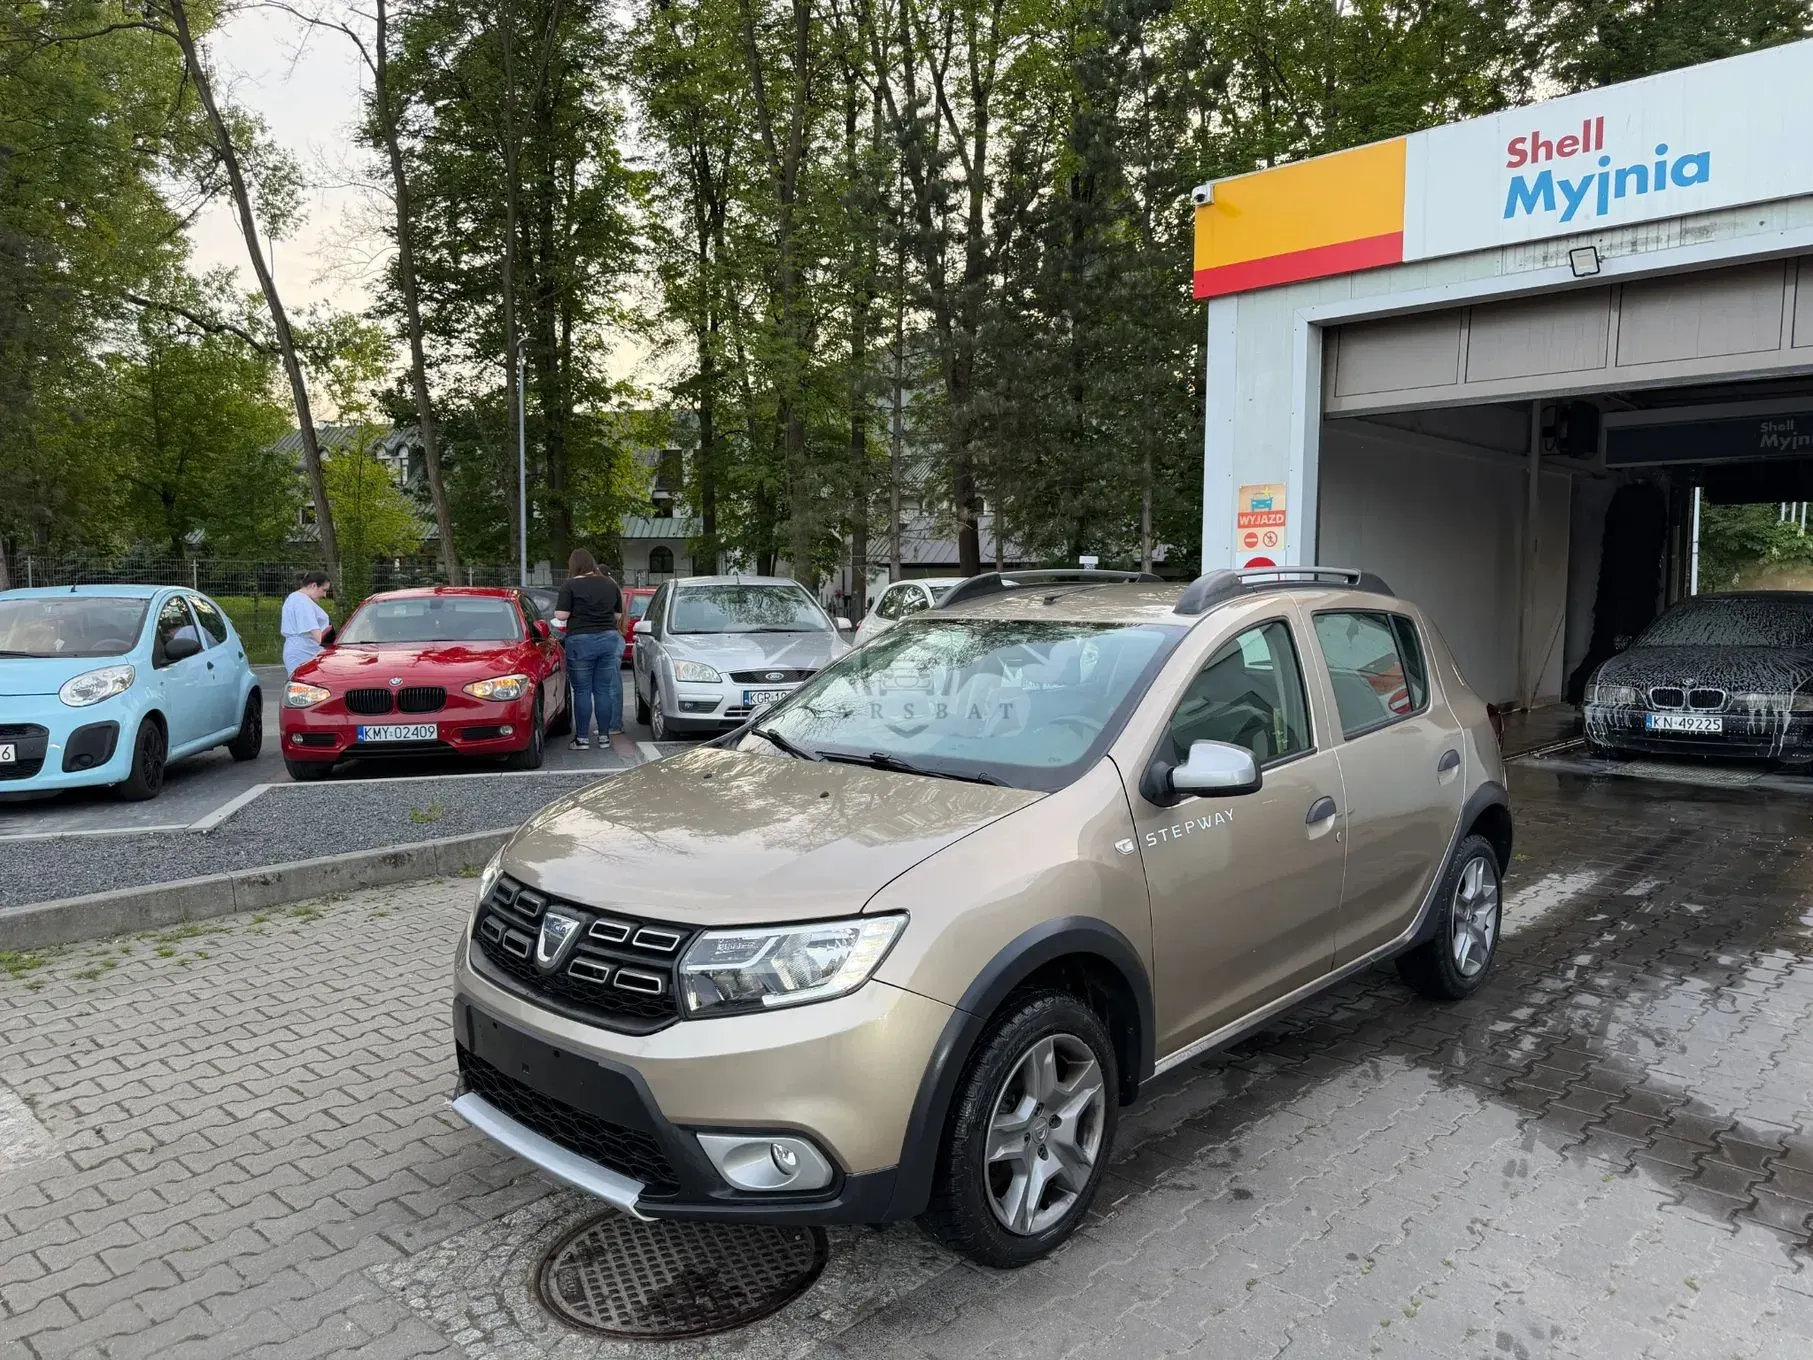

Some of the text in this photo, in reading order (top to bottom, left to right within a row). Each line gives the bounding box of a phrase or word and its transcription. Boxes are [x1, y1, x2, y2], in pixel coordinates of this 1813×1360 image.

[1506, 116, 1604, 168] Shell
[1503, 143, 1711, 223] Myjnia
[1760, 419, 1794, 432] Shell
[1240, 514, 1284, 525] WYJAZD
[750, 692, 771, 704] KGR
[1653, 717, 1721, 731] KN 49225
[364, 725, 435, 740] KMY 02409
[1, 746, 11, 760] 6
[1145, 808, 1234, 847] STEPWAY
